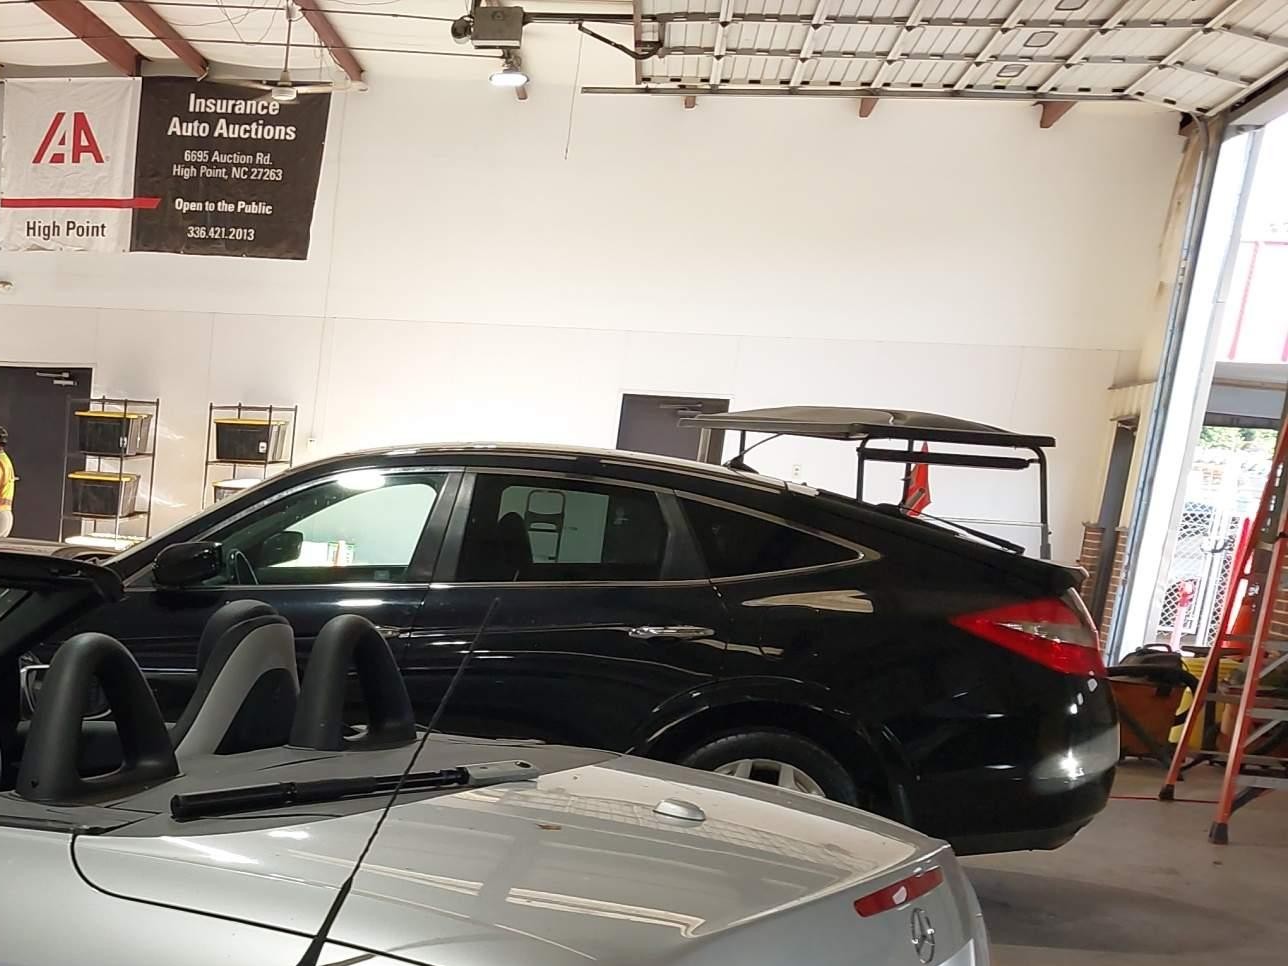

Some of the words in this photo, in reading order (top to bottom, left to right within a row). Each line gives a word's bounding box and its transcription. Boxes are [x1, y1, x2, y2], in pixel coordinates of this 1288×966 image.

[189, 93, 280, 115] Insurance
[167, 117, 210, 136] Auto
[213, 118, 297, 140] Auctions
[184, 150, 209, 162] 6695
[211, 151, 253, 164] Auction
[255, 153, 273, 165] Rd.
[172, 165, 197, 179] High
[199, 166, 228, 180] Point,
[231, 167, 249, 179] NC
[250, 168, 283, 181] 27263
[175, 198, 203, 213] Open
[205, 201, 215, 212] to
[217, 200, 235, 213] the
[237, 201, 273, 215] Public
[26, 221, 61, 240] High
[65, 221, 107, 237] Point
[187, 227, 255, 241] 336.421.2013
